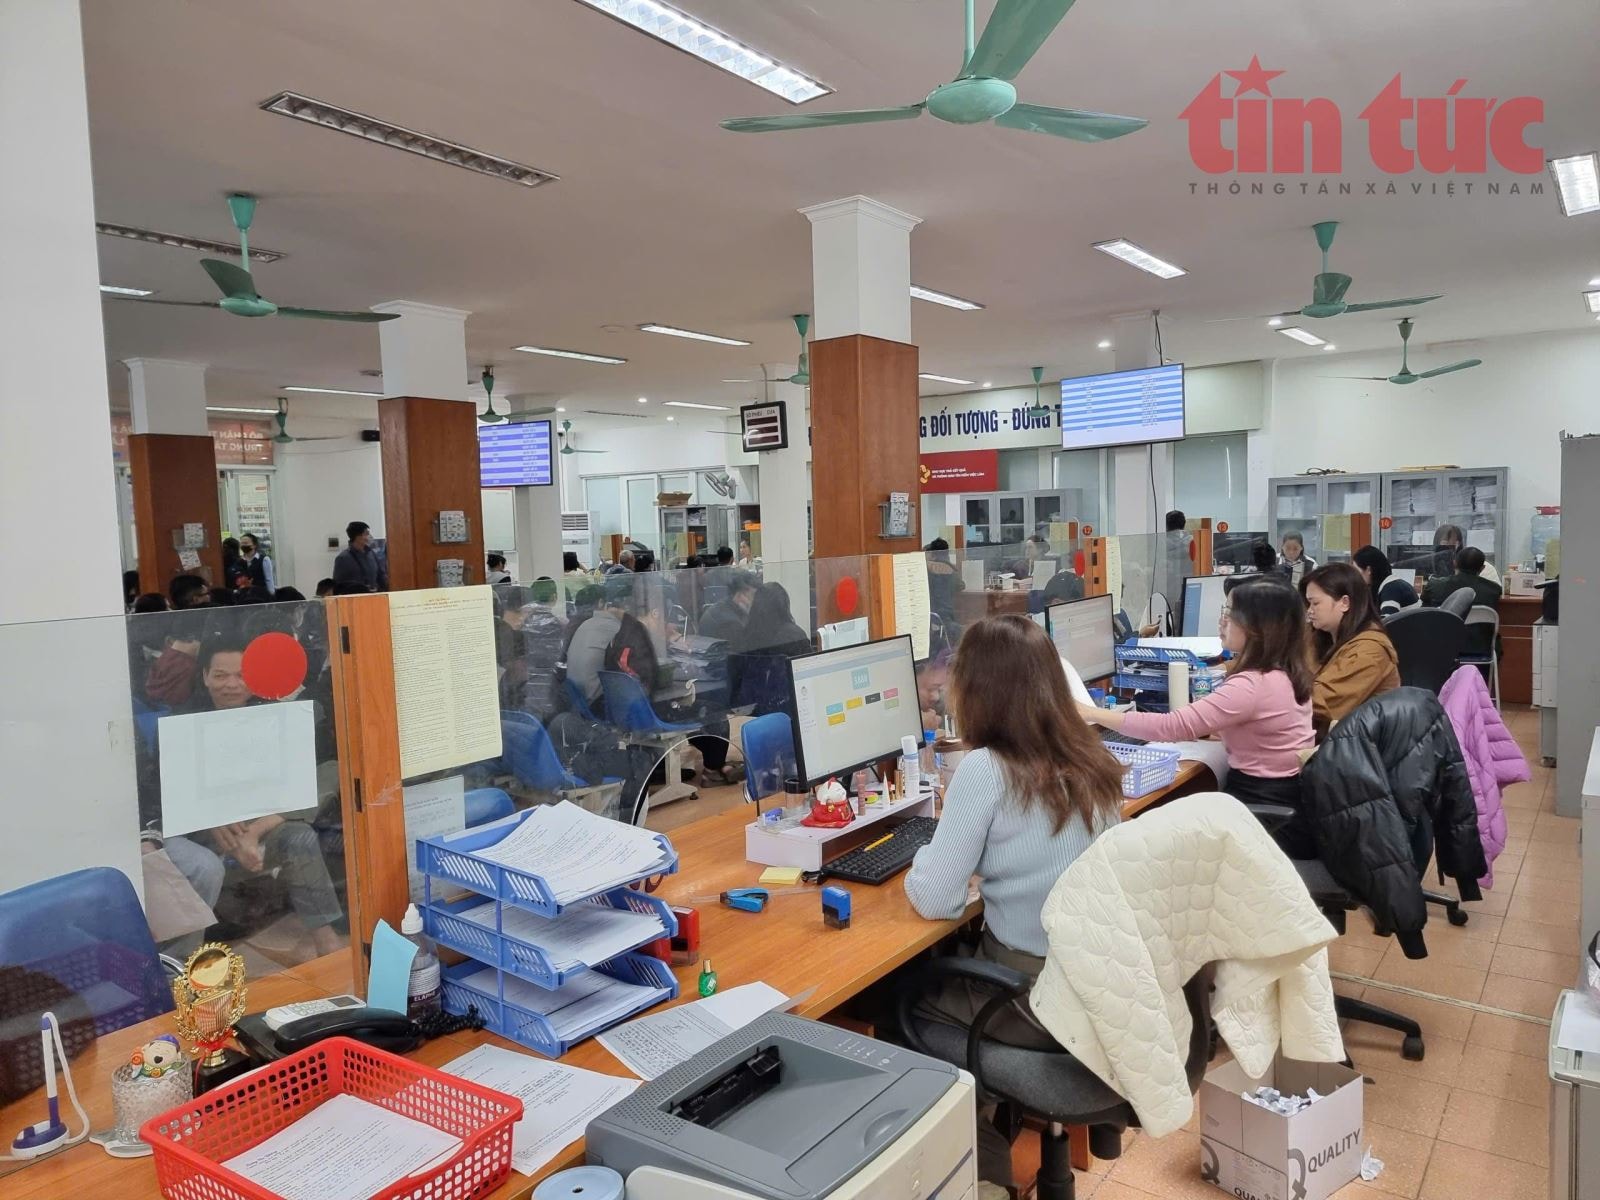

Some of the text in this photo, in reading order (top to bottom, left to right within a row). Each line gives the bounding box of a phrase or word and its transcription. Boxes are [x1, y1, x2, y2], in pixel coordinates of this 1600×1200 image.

[930, 406, 951, 437] ĐỐI
[955, 409, 999, 439] TƯỢNG
[1307, 1128, 1360, 1173] QUALITY
